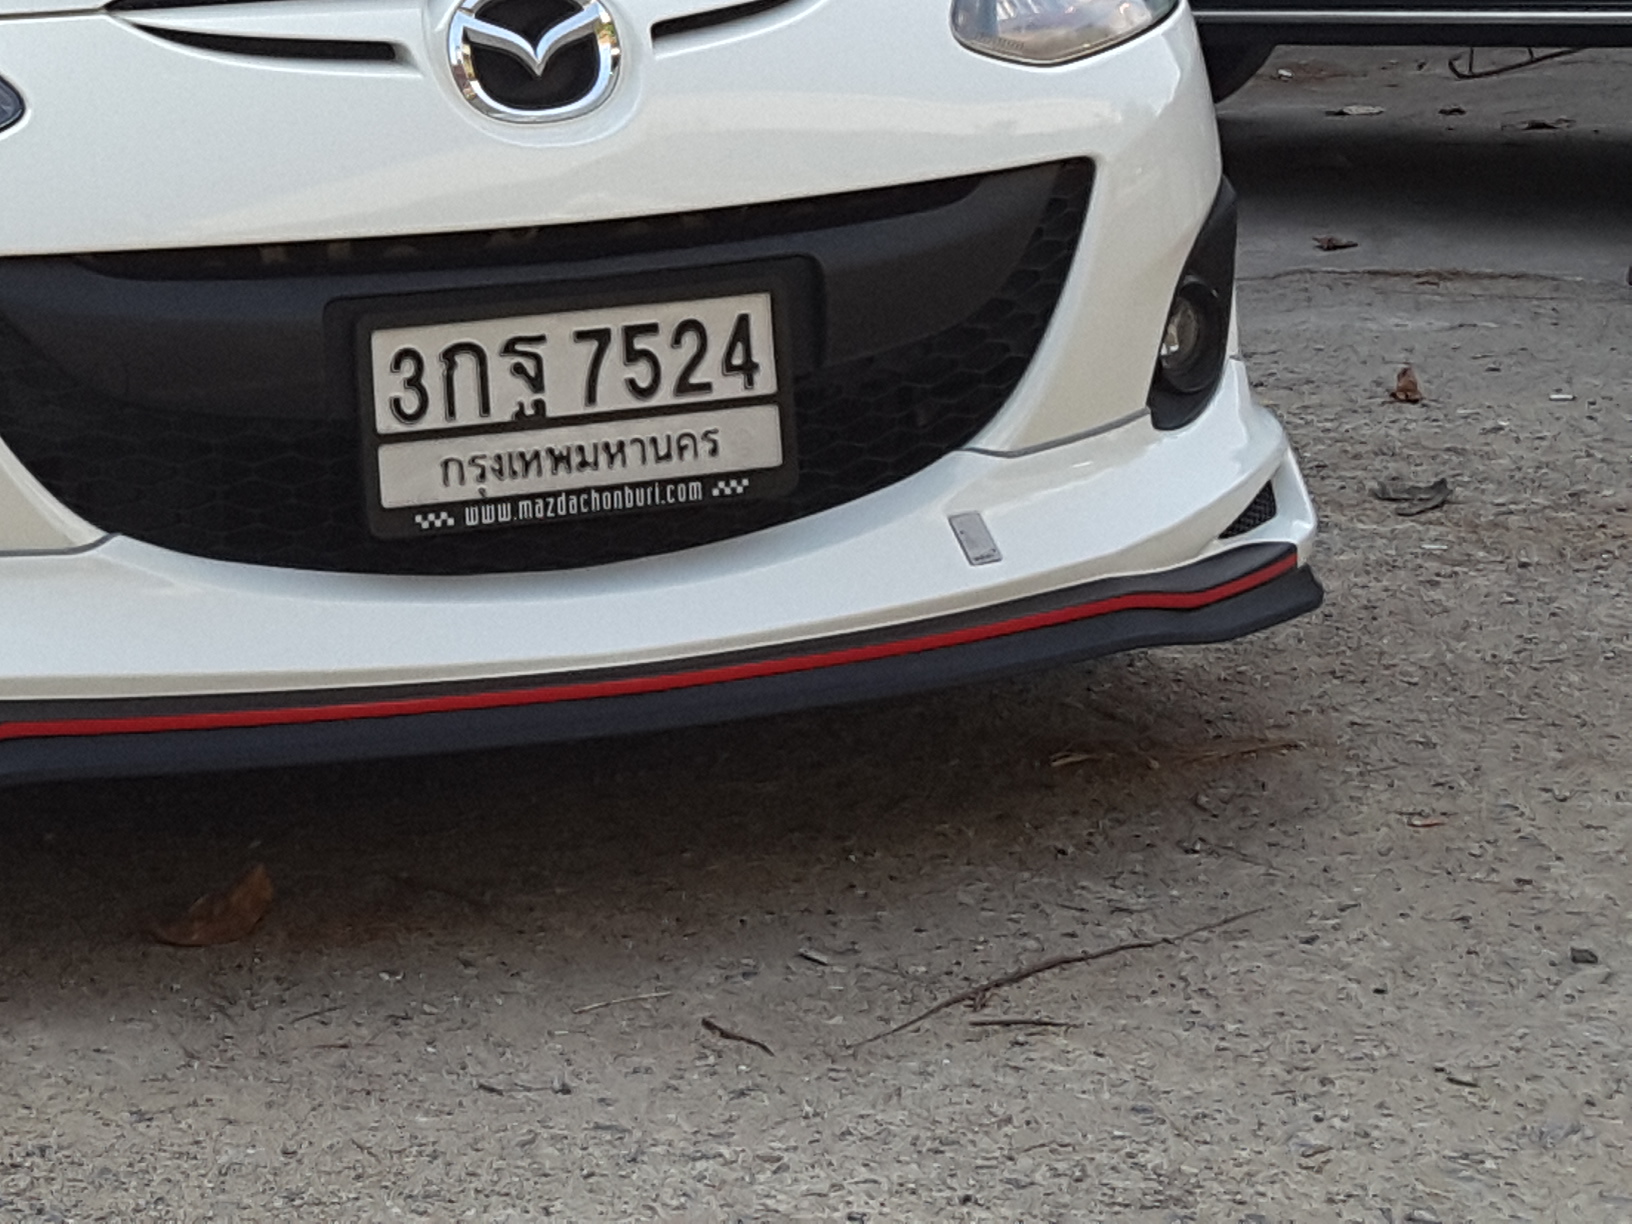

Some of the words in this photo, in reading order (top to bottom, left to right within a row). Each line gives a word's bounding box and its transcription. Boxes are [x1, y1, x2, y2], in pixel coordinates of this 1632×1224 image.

[574, 312, 760, 407] 7524
[440, 428, 720, 496] กรุงเทพมหานคร
